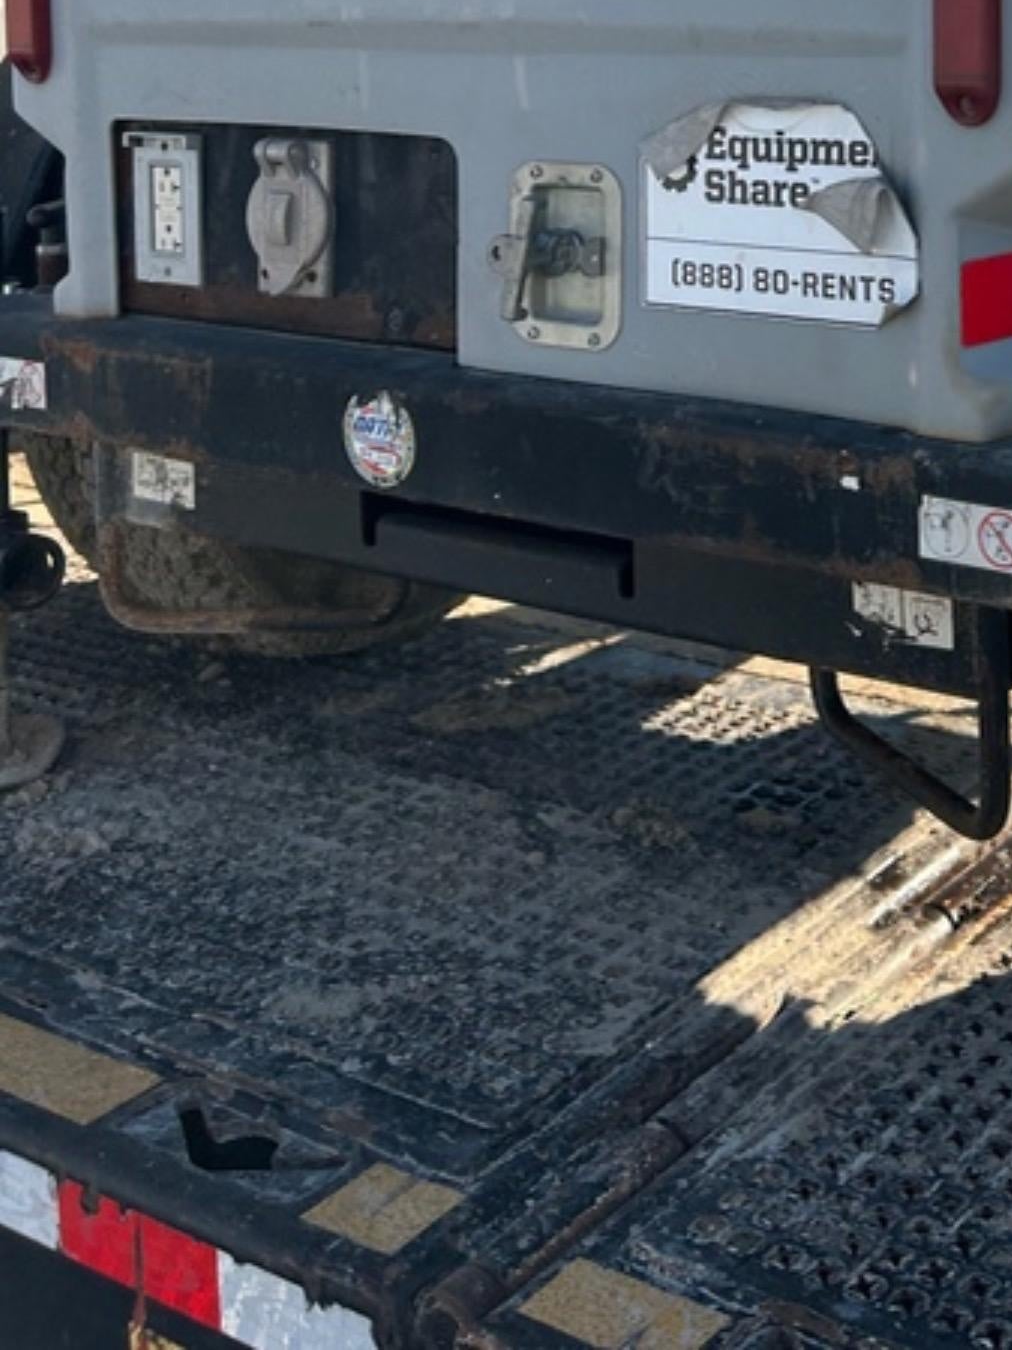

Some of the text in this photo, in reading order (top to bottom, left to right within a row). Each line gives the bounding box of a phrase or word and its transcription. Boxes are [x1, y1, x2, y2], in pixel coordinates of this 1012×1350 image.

[704, 125, 881, 172] Equipme
[704, 169, 811, 208] Share
[671, 258, 896, 303] (888) 80-RENTS
